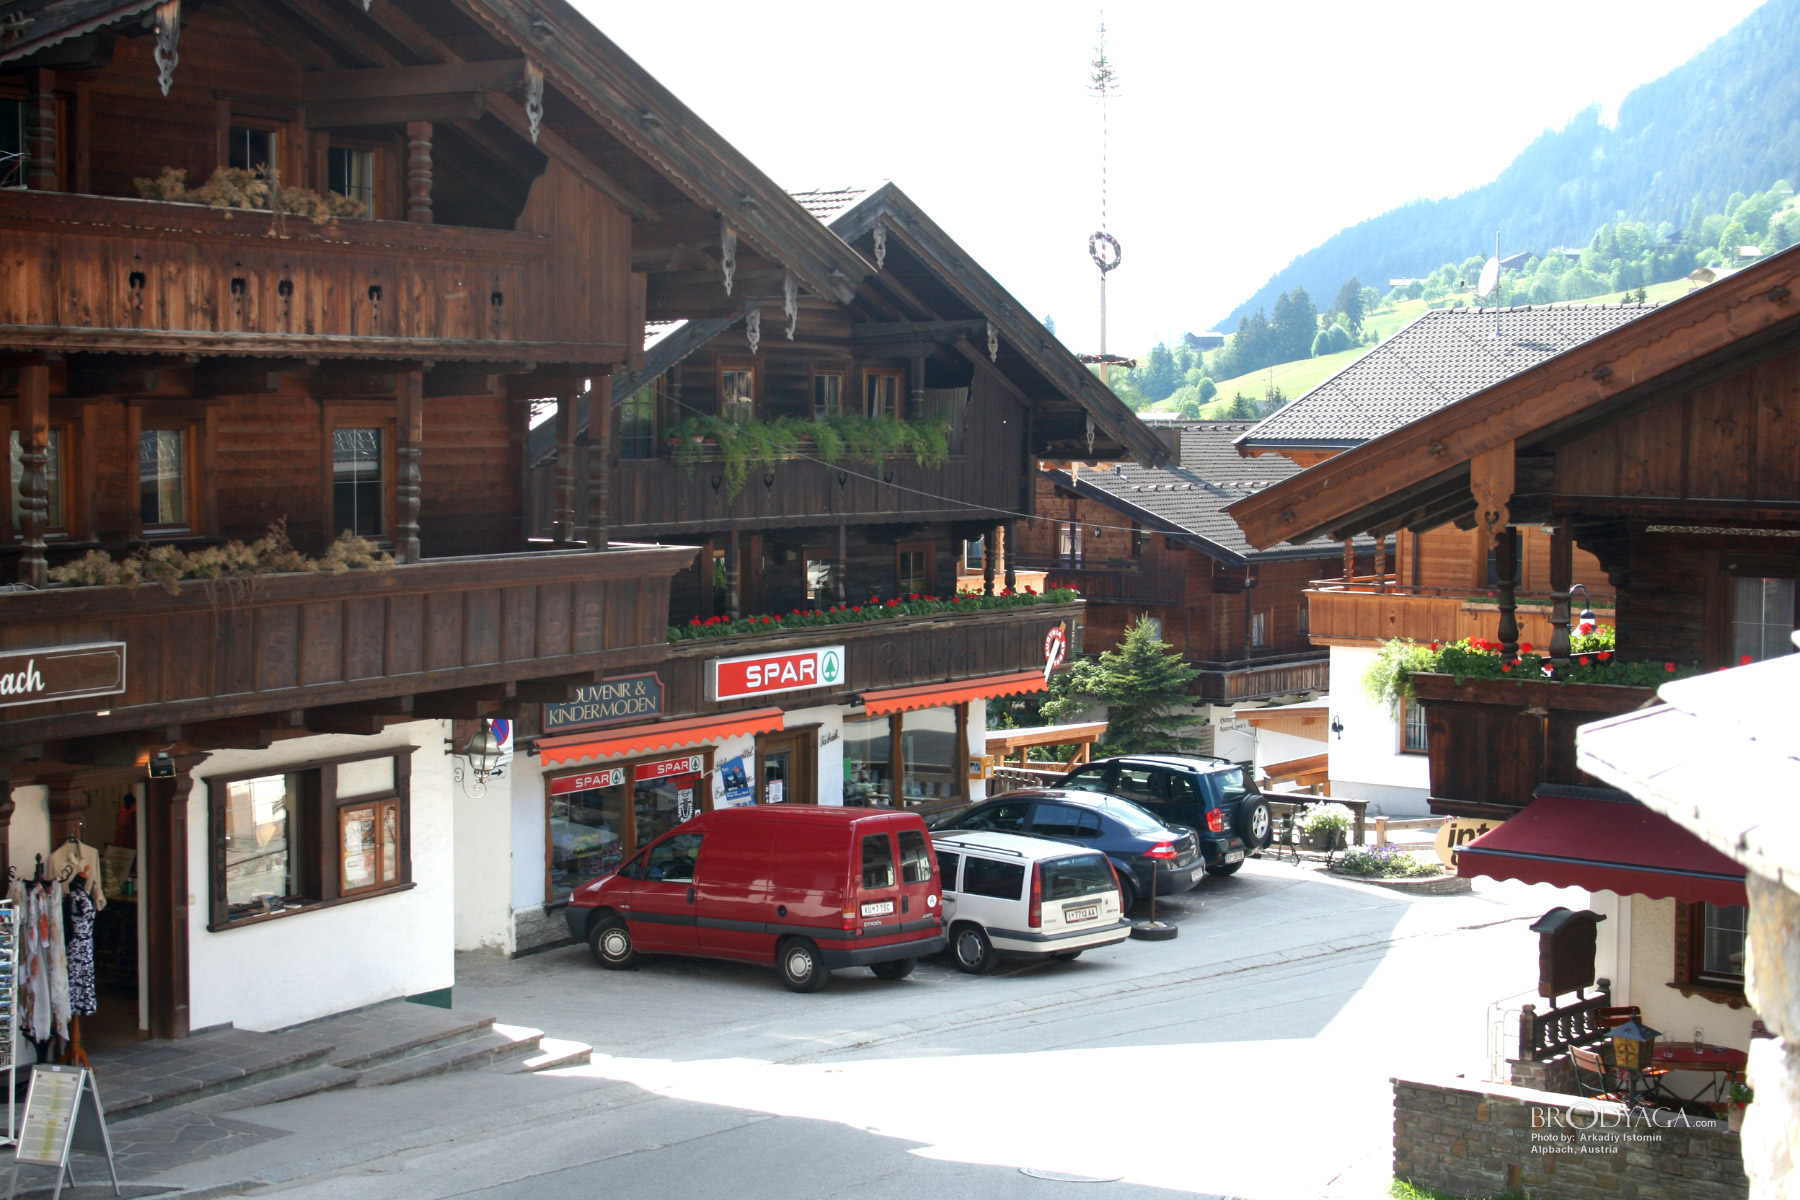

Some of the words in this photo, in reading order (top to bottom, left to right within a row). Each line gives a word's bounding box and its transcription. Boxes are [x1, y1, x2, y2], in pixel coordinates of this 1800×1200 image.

[0, 659, 45, 695] ach
[746, 658, 815, 688] SPAR
[560, 682, 631, 705] OUVENIR
[635, 680, 646, 696] &
[549, 696, 656, 725] KINDERMODEN
[657, 760, 689, 775] SPAR
[575, 773, 610, 788] SPAR
[930, 896, 935, 904] A
